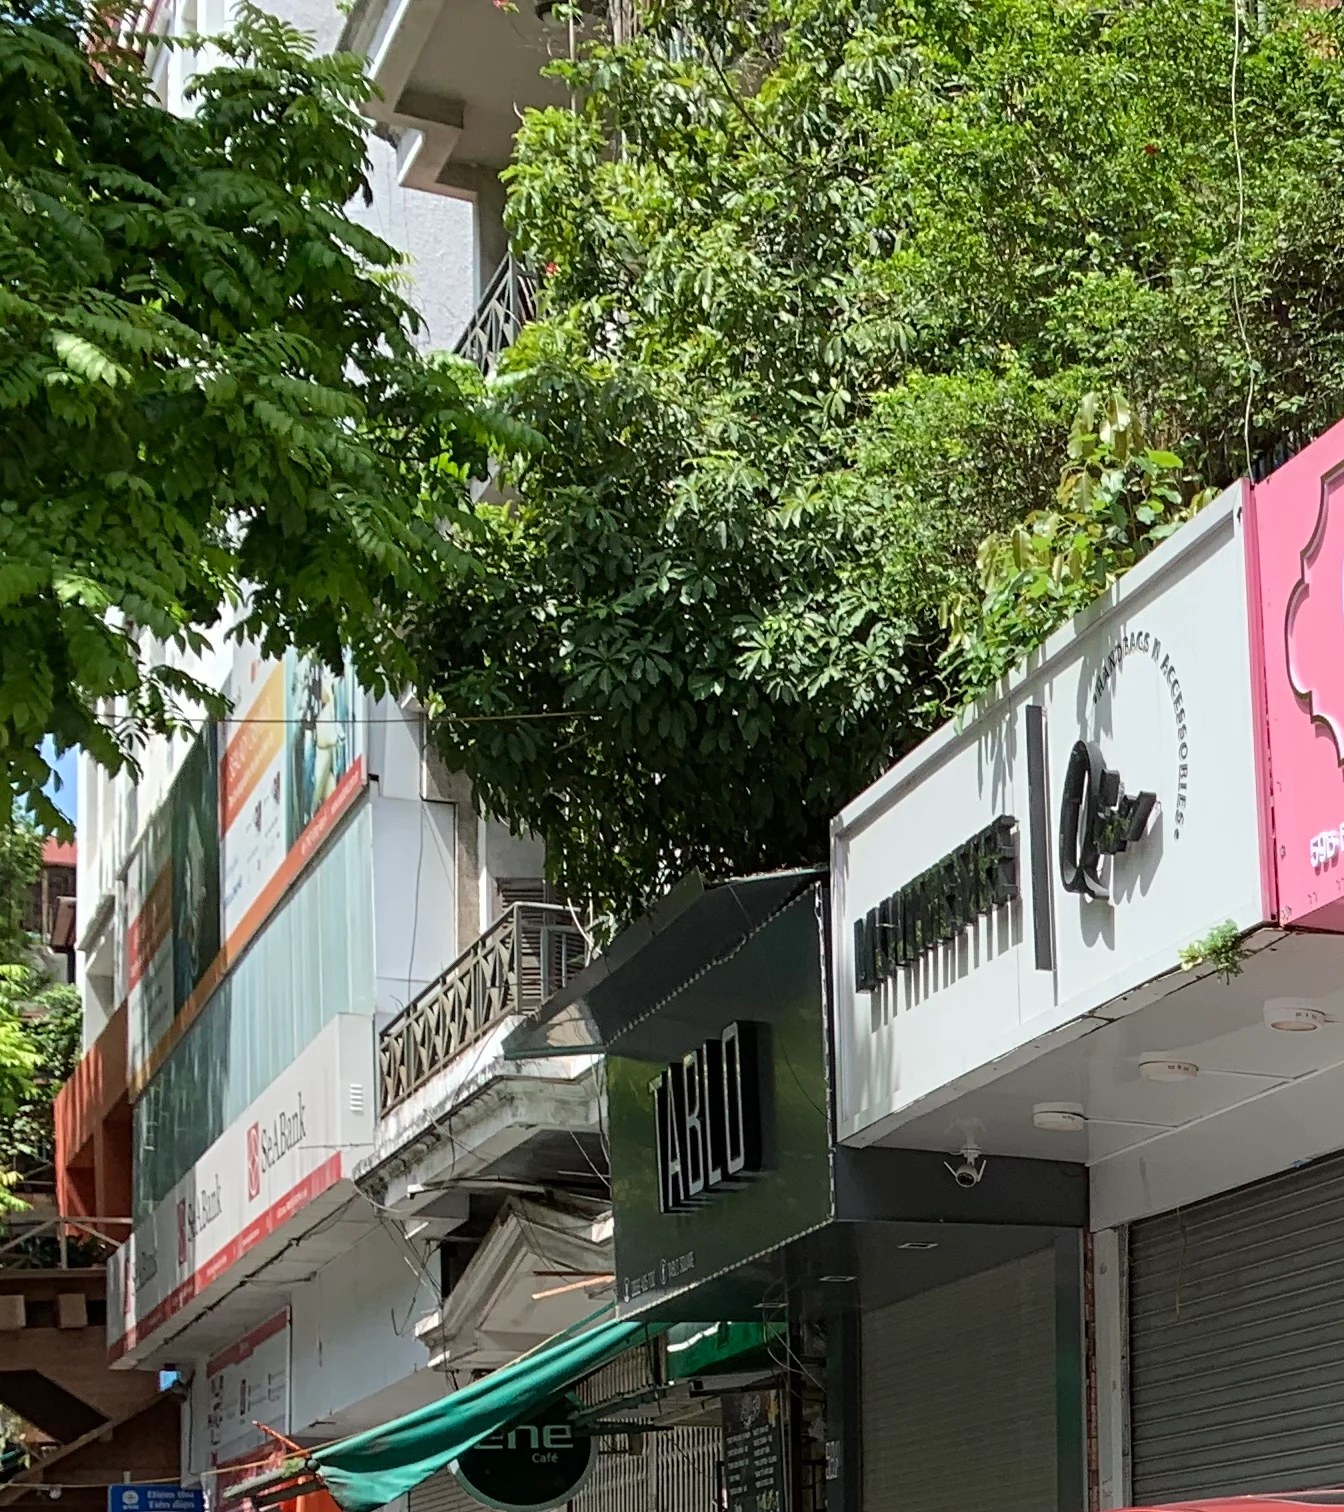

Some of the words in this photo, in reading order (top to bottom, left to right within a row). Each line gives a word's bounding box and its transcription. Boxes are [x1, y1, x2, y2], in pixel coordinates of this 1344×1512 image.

[1095, 631, 1150, 697] HANDBAGS
[1160, 653, 1189, 829] ACCESSORIES
[261, 1091, 306, 1174] SeABank
[649, 1020, 750, 1214] TABLO
[532, 1452, 559, 1464] Café
